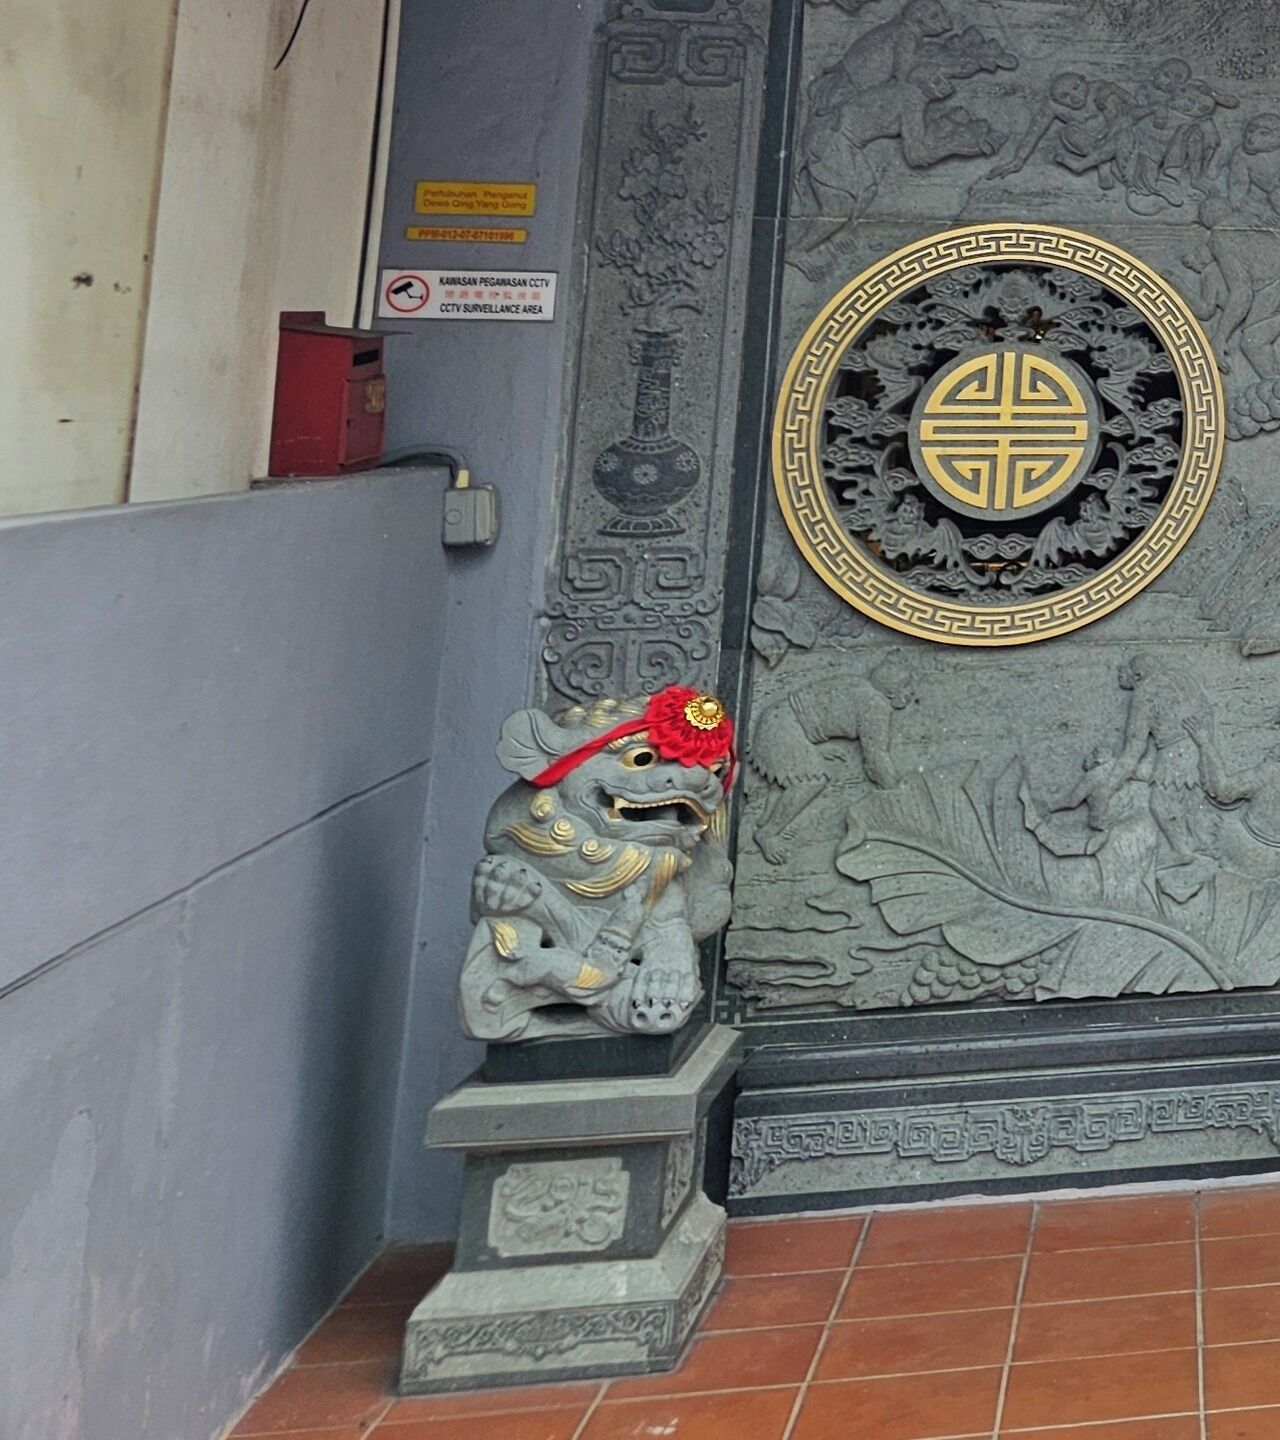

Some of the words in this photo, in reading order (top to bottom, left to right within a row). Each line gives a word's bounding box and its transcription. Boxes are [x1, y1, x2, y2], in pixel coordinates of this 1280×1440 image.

[439, 276, 478, 287] KAWASAN
[479, 277, 527, 287] PEGAWASAN
[529, 278, 550, 288] CCTV
[440, 303, 462, 313] CCTV
[463, 304, 521, 314] SURVEILLANCE
[522, 305, 543, 314] AREA
